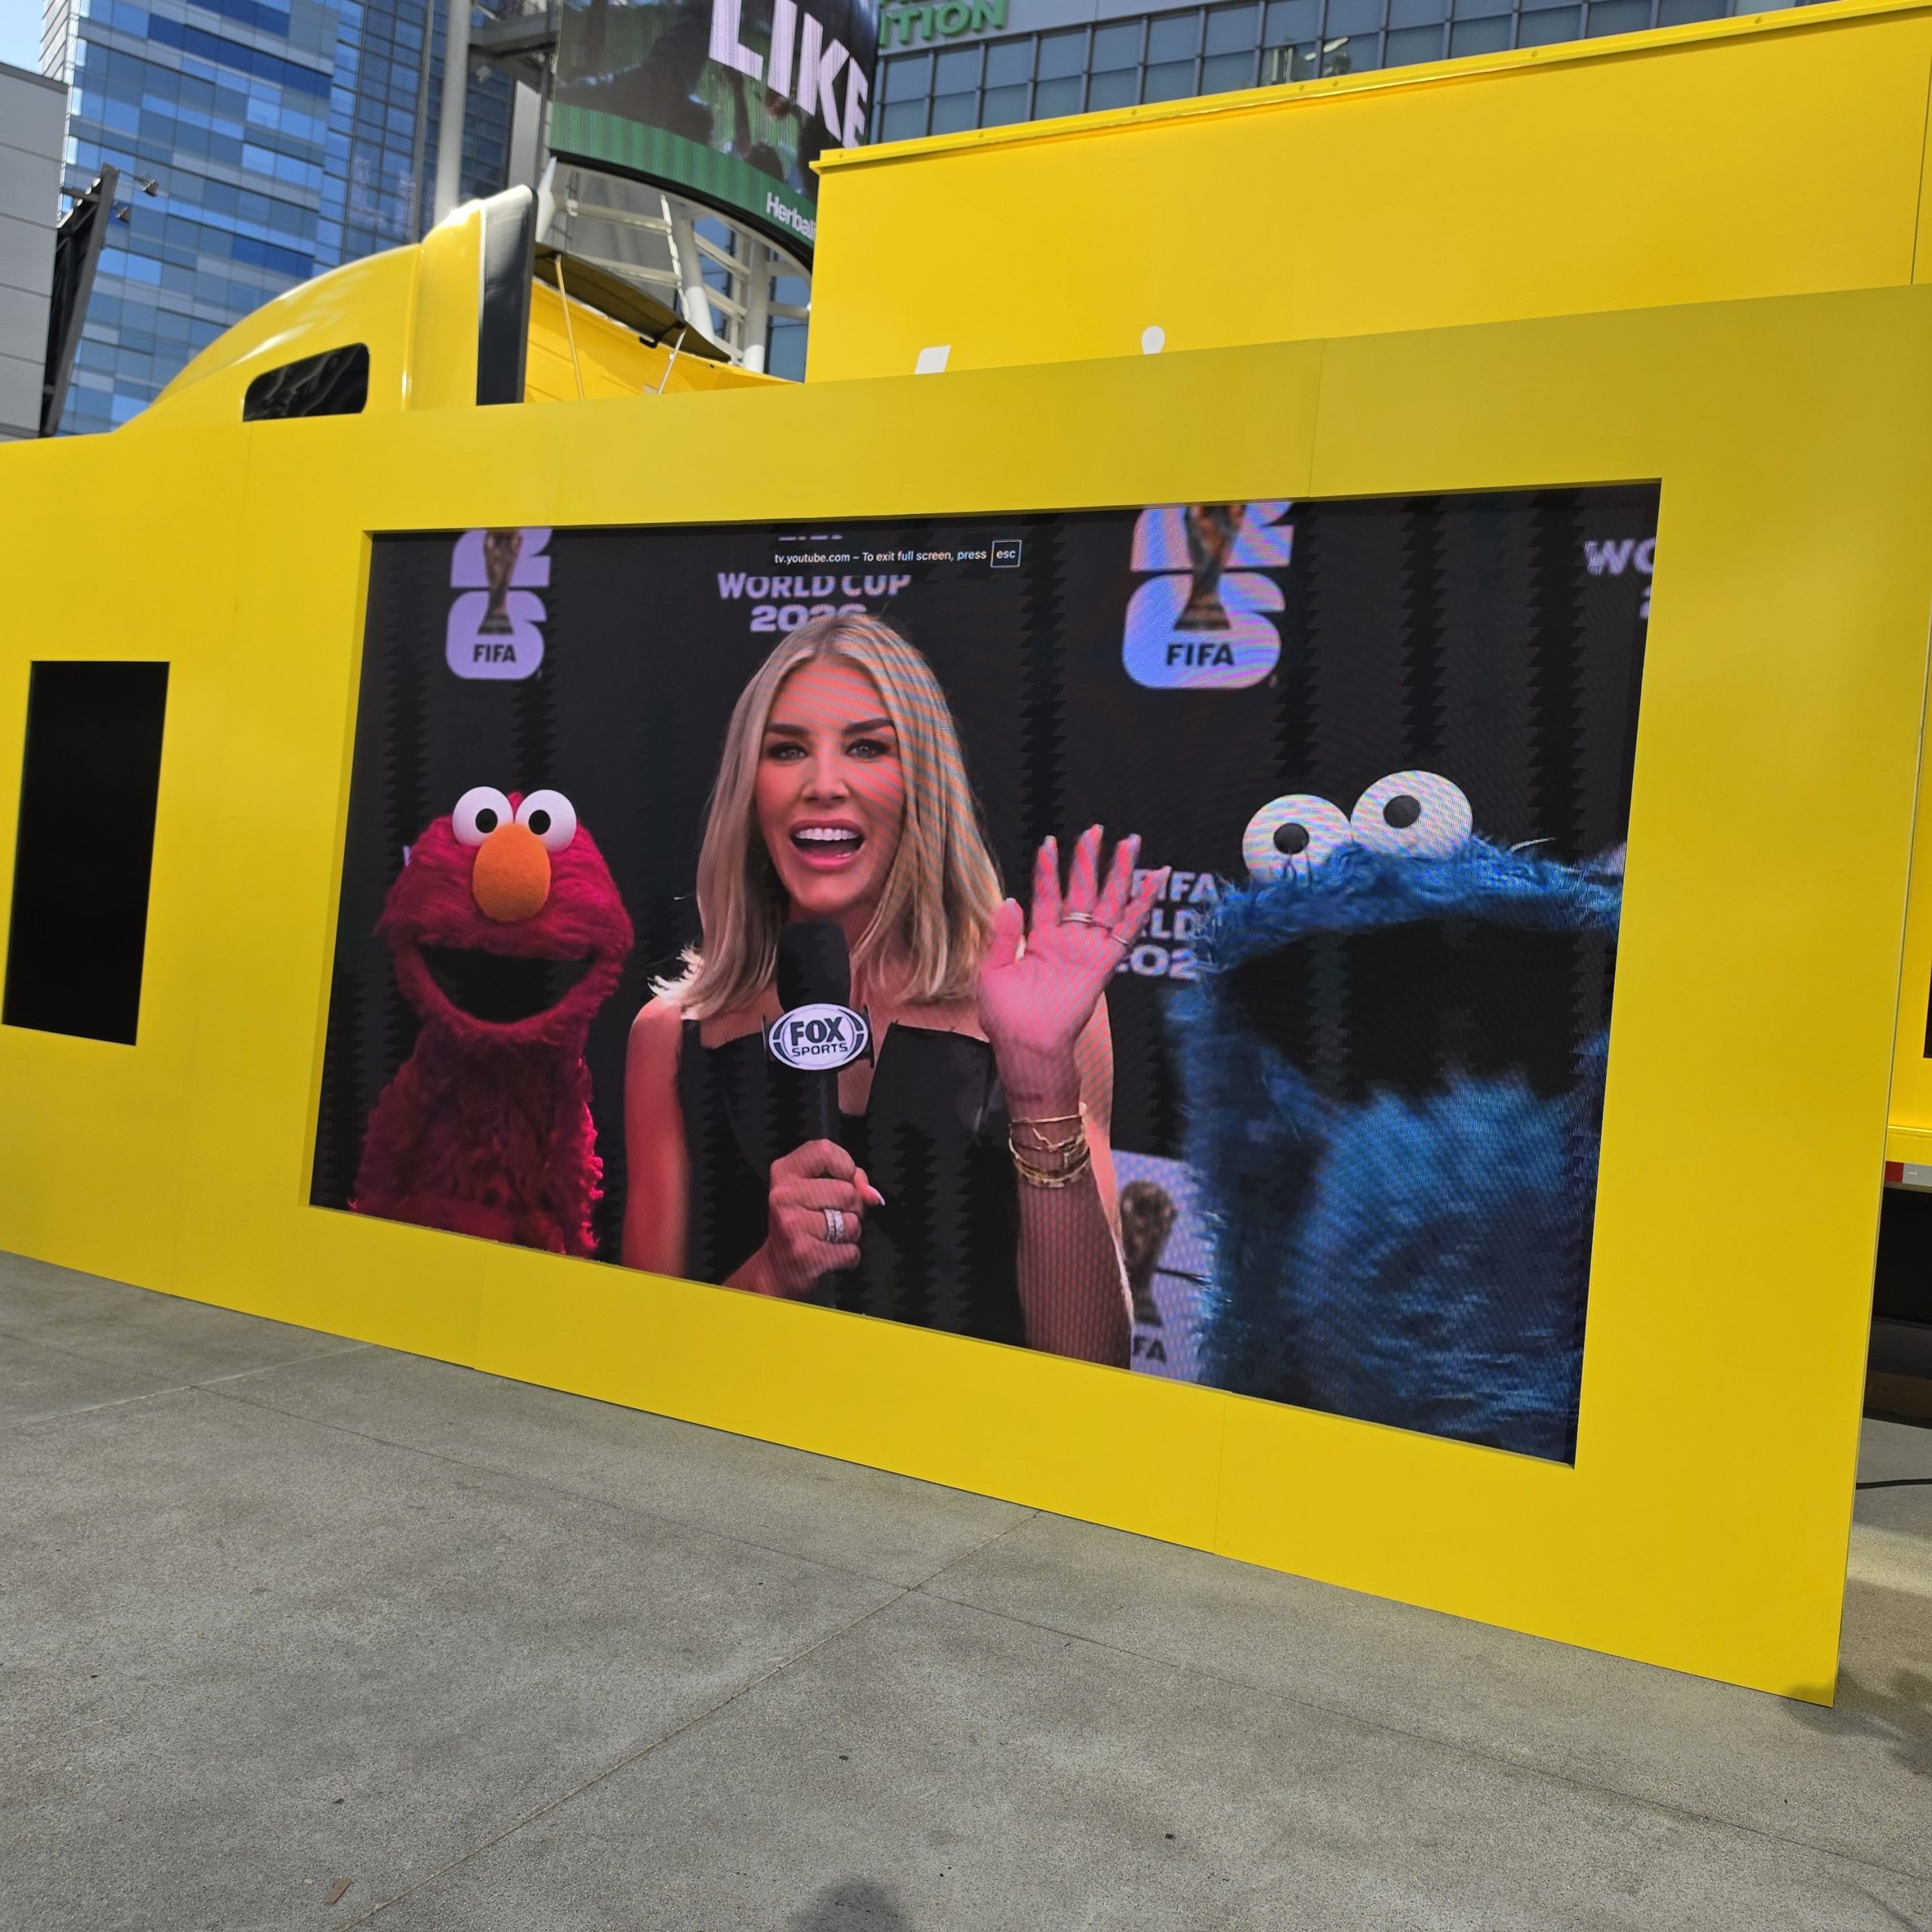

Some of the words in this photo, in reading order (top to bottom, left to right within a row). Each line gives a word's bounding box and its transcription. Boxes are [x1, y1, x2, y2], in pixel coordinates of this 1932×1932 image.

[708, 0, 869, 148] LIKE
[774, 552, 850, 565] tv.youtube.com
[862, 552, 874, 562] To
[876, 550, 895, 561] exit
[897, 550, 915, 561] full
[916, 551, 954, 561] screen,
[957, 550, 987, 561] press
[996, 549, 1016, 559] esc
[718, 572, 836, 599] WORLD
[841, 574, 912, 597] CUP
[473, 645, 516, 663] FIFA
[1167, 643, 1235, 666] FIFA
[790, 1017, 845, 1046] FOX
[792, 1044, 848, 1057] SPORTS
